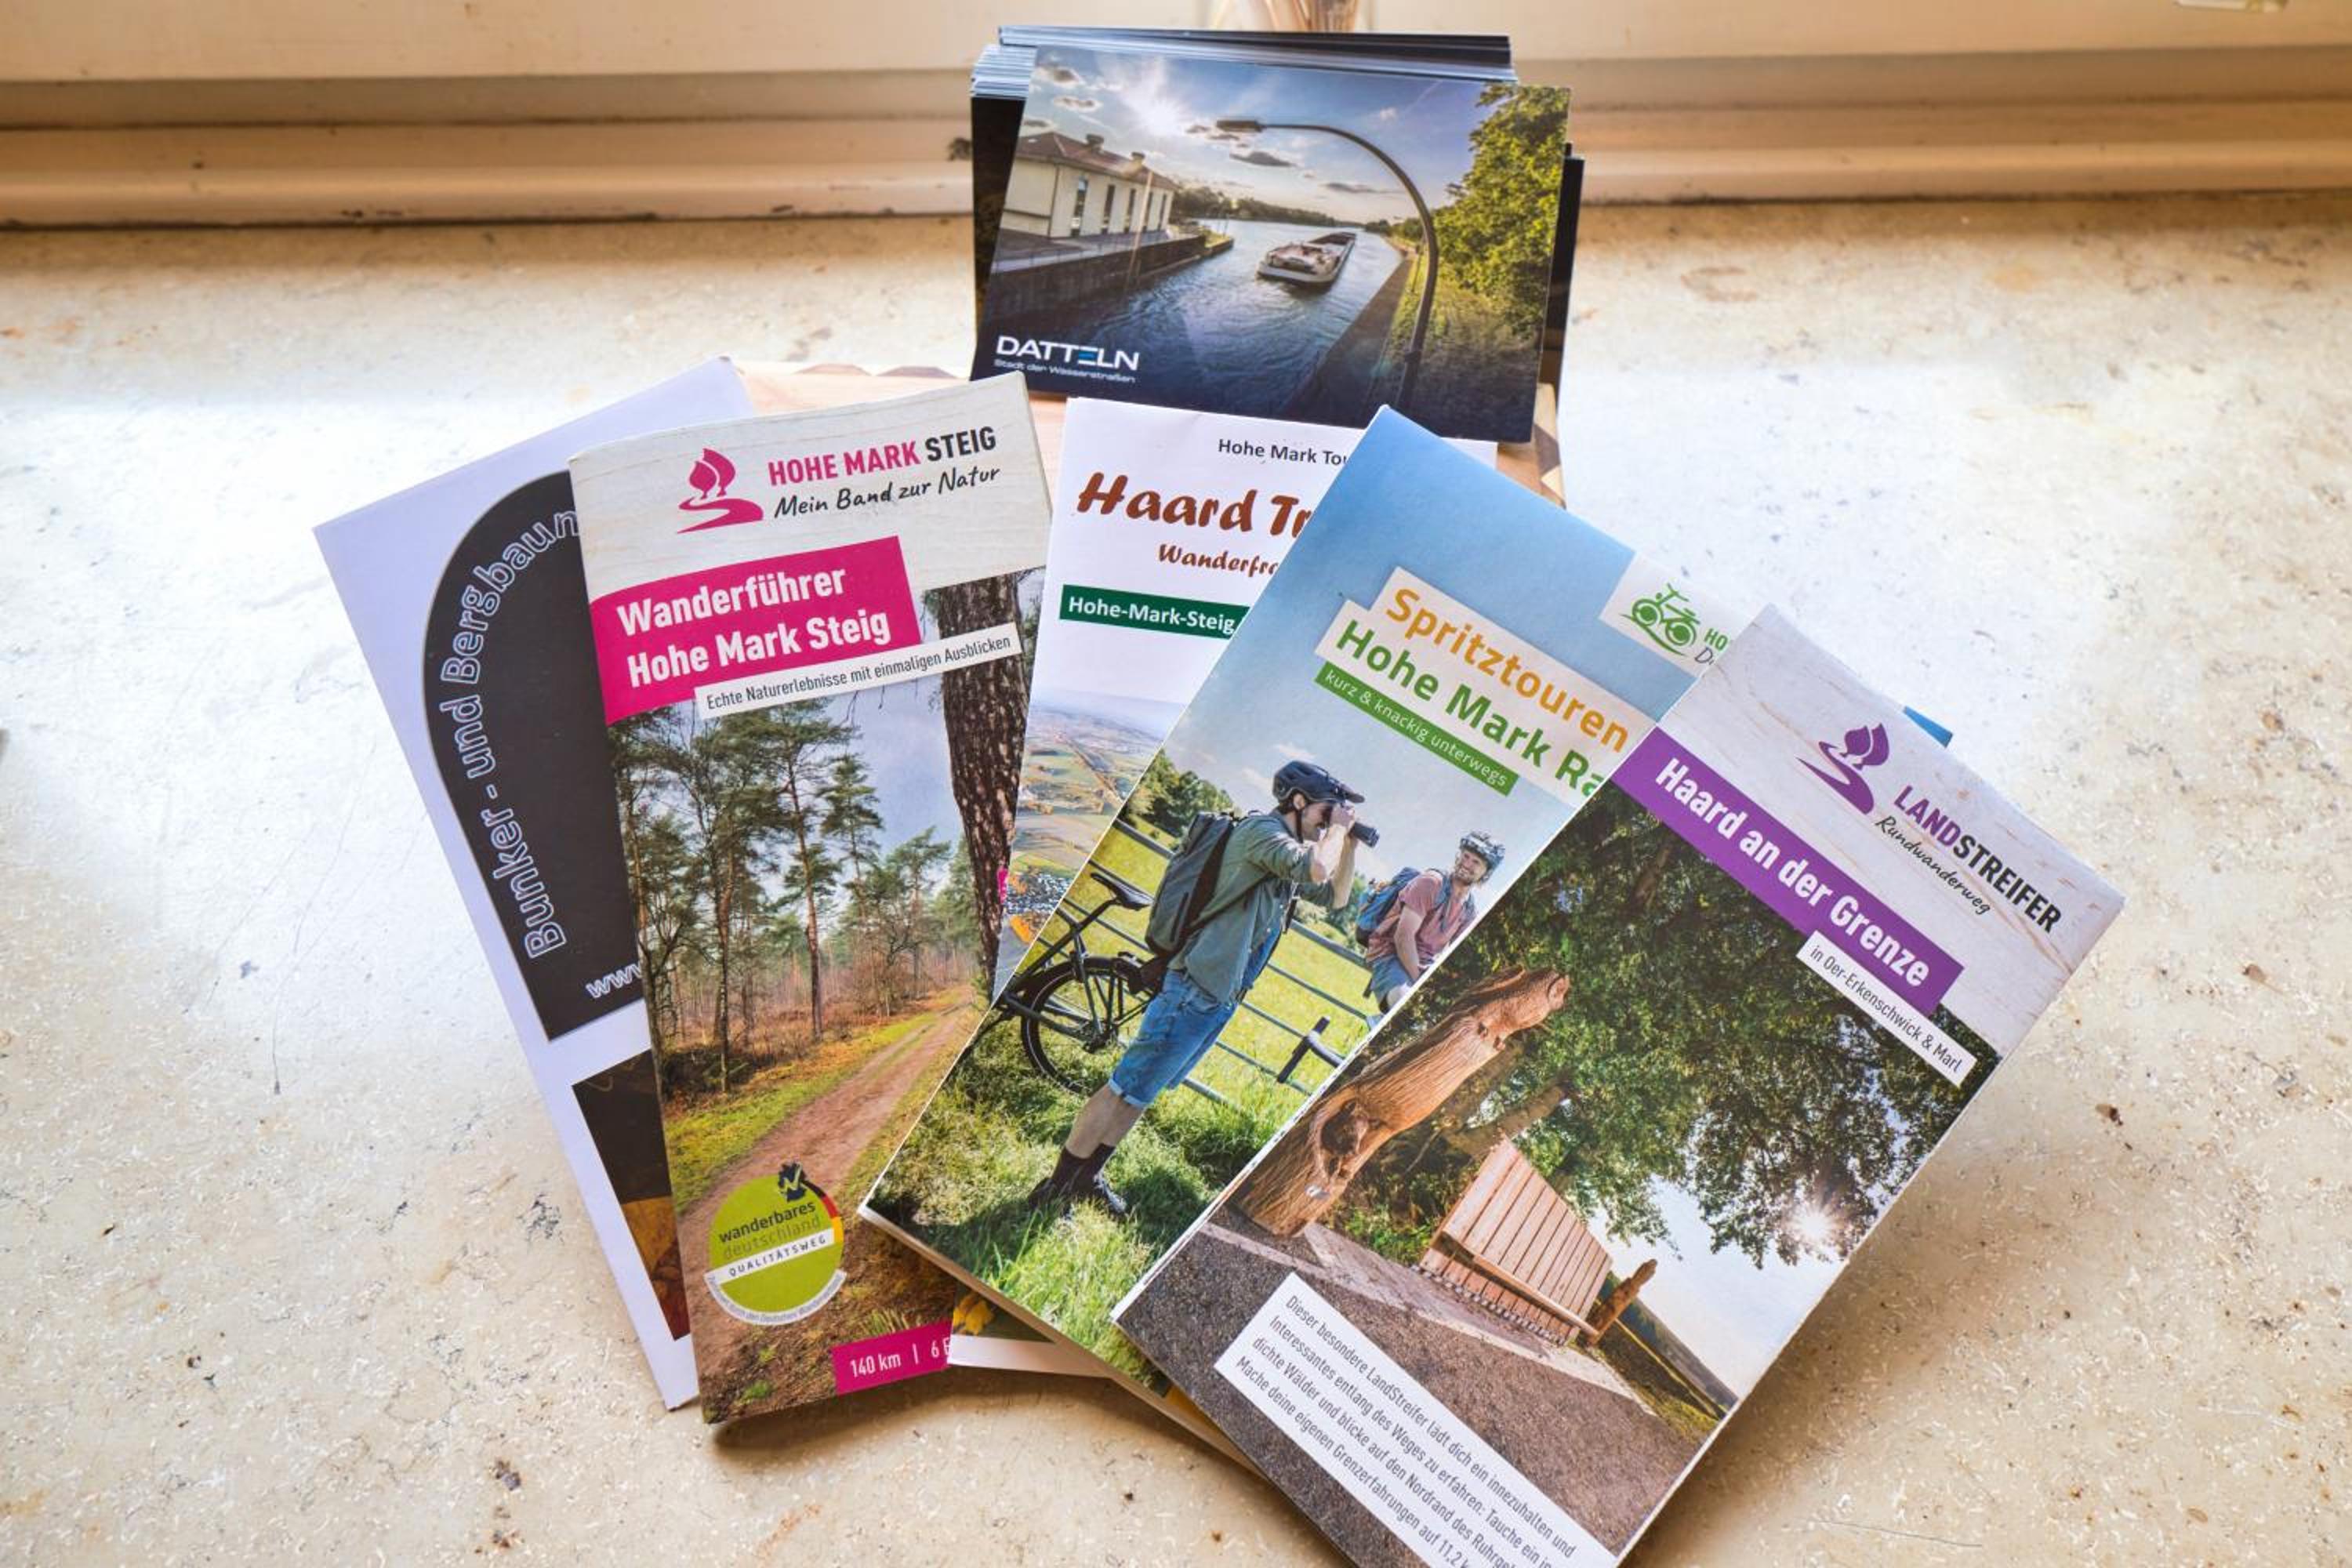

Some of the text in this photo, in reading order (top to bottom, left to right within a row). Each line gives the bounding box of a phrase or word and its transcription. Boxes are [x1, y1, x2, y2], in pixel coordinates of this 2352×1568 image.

[996, 336, 1140, 371] DATTELN
[768, 426, 996, 486] HOHE MARK STEIG
[774, 466, 1000, 519] Mein Band zur Natur
[1218, 438, 1347, 466] Hohe Mark To
[1076, 472, 1258, 533] Haard
[616, 568, 847, 637] Wanderführer
[1068, 596, 1236, 636] Hohe-Mark-Steig
[627, 609, 891, 688] Hohe Mark Steig
[706, 636, 1011, 710] Echte Naturerlebnisse mit einmaligen Ausblicken
[1385, 588, 1630, 754] Spritztouren
[439, 693, 497, 779] und
[1325, 670, 1508, 788] kurz & knackig unterwegs
[1336, 619, 1439, 702] Hohe
[1444, 684, 1552, 768] Mark
[481, 808, 568, 960] Bunker
[1655, 757, 1930, 987] Haard an der Grenze
[1875, 815, 1991, 916] Rundwanderweg
[1893, 786, 2062, 933] LANDSTREIFER
[1809, 945, 1962, 1073] in Oer-Erkenschwick & Marl
[719, 1201, 815, 1243] wanderbares
[724, 1216, 821, 1260] deutschland
[850, 1355, 876, 1378] 140
[878, 1352, 901, 1372] km
[931, 1340, 940, 1358] 6
[1236, 1356, 1270, 1392] Mache
[1268, 1386, 1298, 1415] deine
[1294, 1410, 1334, 1451] eigenen
[1332, 1444, 1421, 1530] Grenzerfahrungen
[1418, 1523, 1442, 1547] auf
[1252, 1335, 1285, 1370] dichte
[1283, 1362, 1321, 1401] Wälder
[1318, 1396, 1343, 1419] und
[1337, 1412, 1370, 1447] blicke
[1367, 1442, 1390, 1464] auf
[1385, 1457, 1407, 1480] den
[1404, 1473, 1456, 1523] Nordrand
[1451, 1514, 1474, 1541] des
[1269, 1314, 1337, 1381] Interessantes
[1334, 1375, 1374, 1417] entlang
[1371, 1405, 1394, 1432] des
[1391, 1423, 1427, 1463] Weges
[1424, 1457, 1440, 1475] zu
[1437, 1468, 1486, 1516] erfahren:
[1484, 1508, 1523, 1549] Tauche
[1521, 1544, 1542, 1565] ein
[1285, 1295, 1577, 1559] Dieser besondere LandStreifer lädt dich ein innezuhalten und
